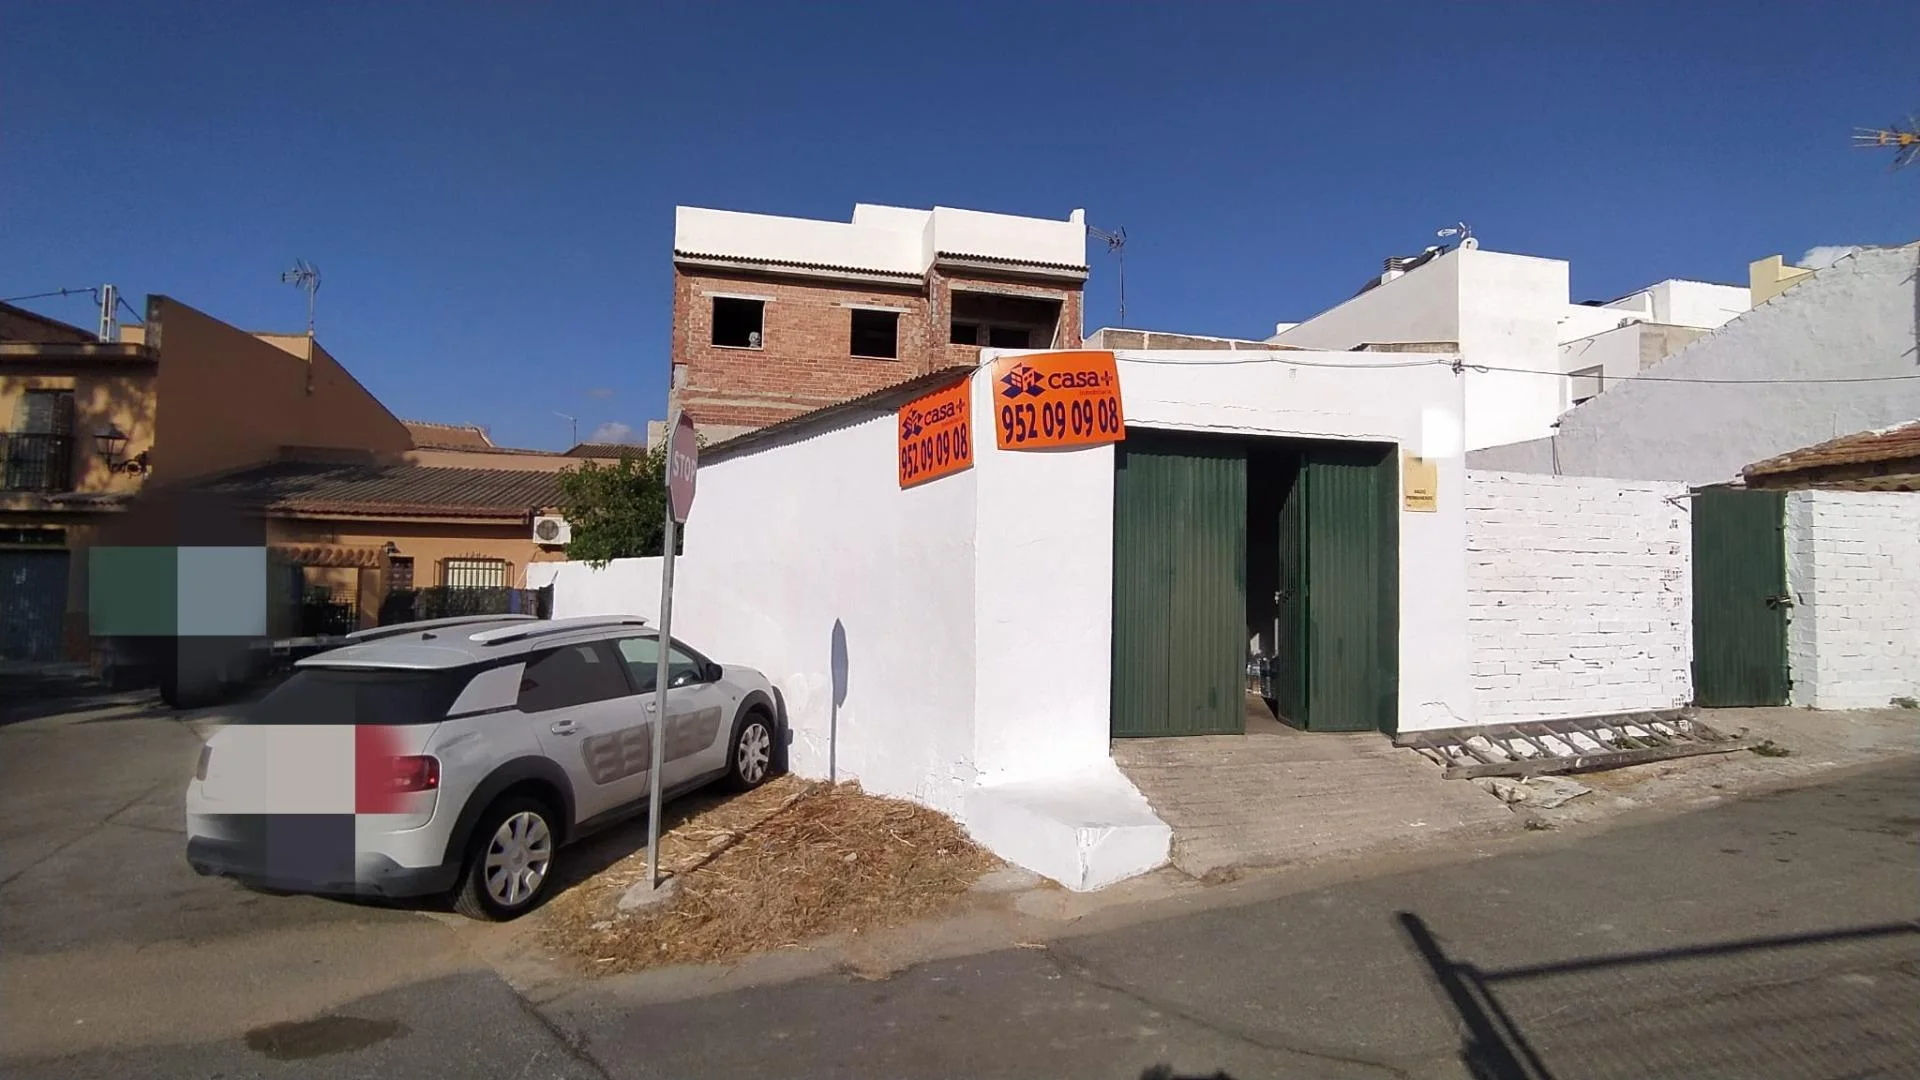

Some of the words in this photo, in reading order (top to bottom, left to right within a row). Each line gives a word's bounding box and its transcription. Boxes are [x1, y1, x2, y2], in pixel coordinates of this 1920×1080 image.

[1002, 403, 1038, 444] 952
[1042, 401, 1066, 440] 09
[1071, 400, 1093, 437] 09
[1098, 396, 1119, 434] 08
[673, 450, 697, 482] STOP
[902, 442, 919, 481] 952
[921, 436, 933, 472] 09
[936, 430, 950, 467] 09
[953, 422, 968, 460] 08
